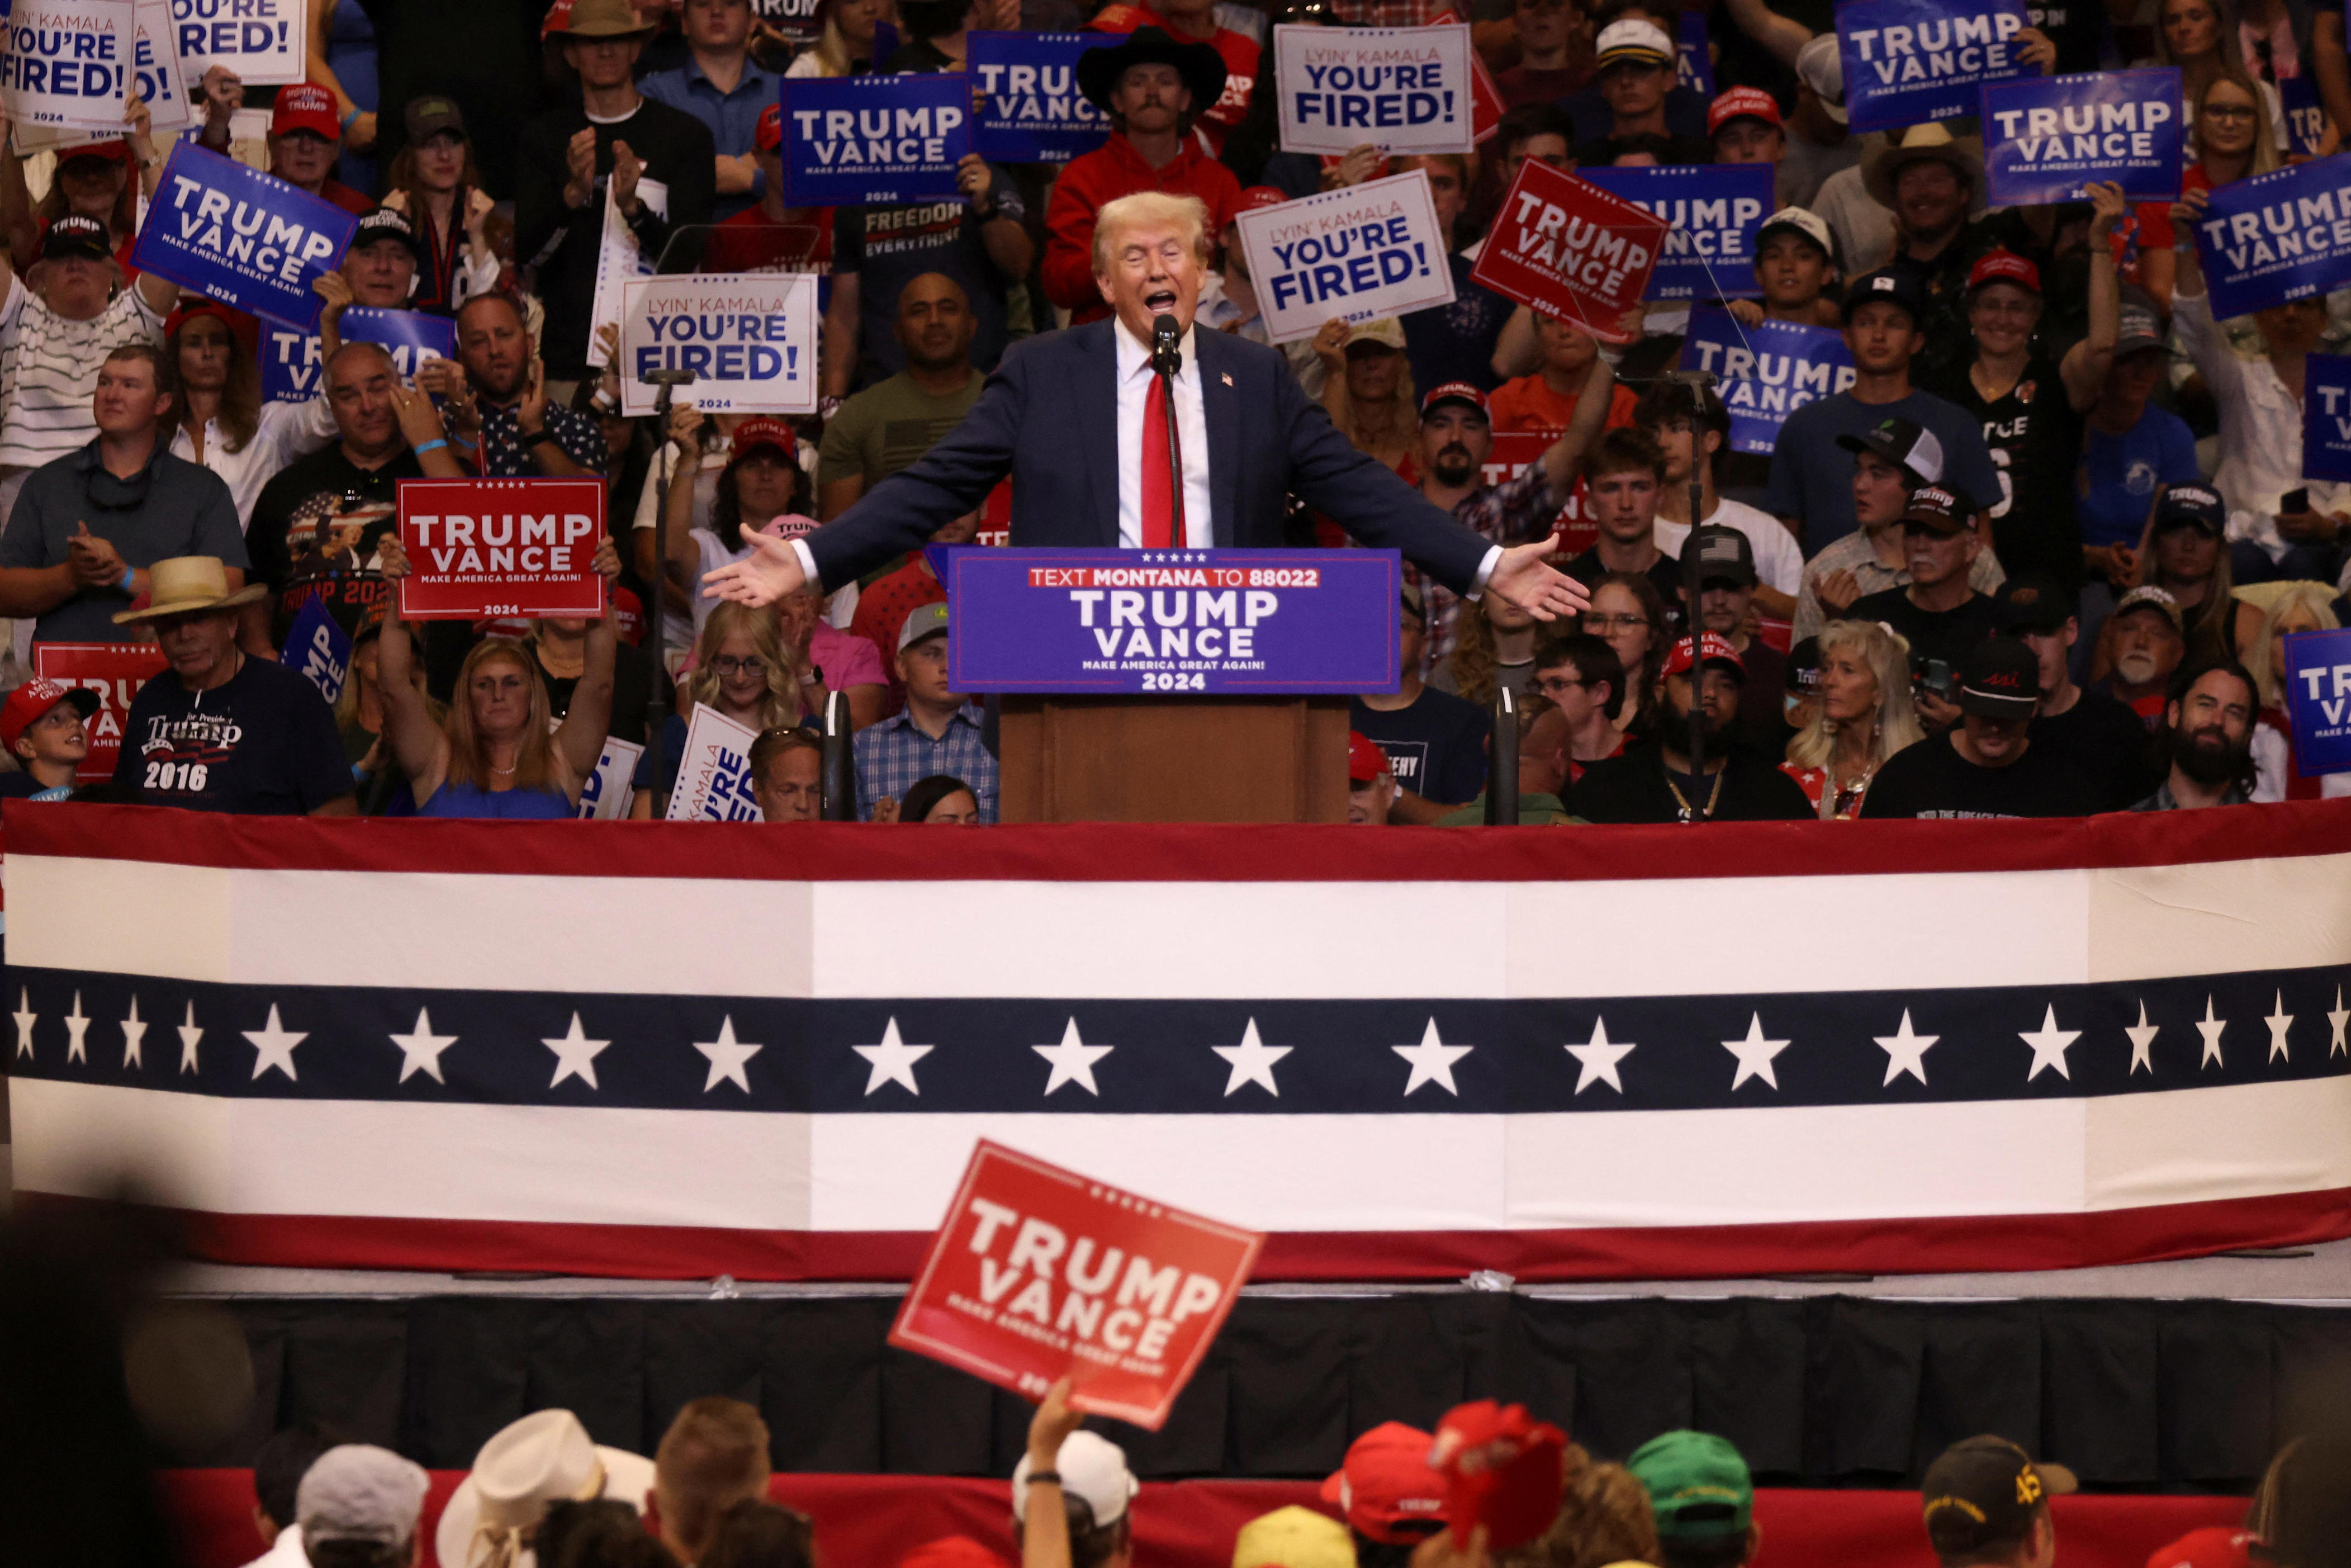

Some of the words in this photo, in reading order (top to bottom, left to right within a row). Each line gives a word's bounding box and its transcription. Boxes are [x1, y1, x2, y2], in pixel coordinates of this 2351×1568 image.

[11, 10, 35, 25] YIN'
[40, 13, 115, 32] KAMALA
[173, 0, 277, 20] OU'RE
[751, 0, 818, 17] RUM
[11, 26, 116, 60] YOU'RE
[179, 21, 288, 57] RED!
[1848, 12, 2022, 62] TRUMP
[1305, 49, 1350, 63] LYIN'
[1357, 47, 1442, 63] KAMALA
[1873, 43, 2009, 85] VANCE
[1, 54, 123, 98] FIRED!
[978, 64, 1083, 96] TRU
[1305, 64, 1442, 91] YOU'RE
[1867, 86, 1897, 98] MAKE
[1899, 78, 1945, 94] AMERICA
[1947, 72, 1980, 86] GREAT
[1982, 68, 2019, 80] AGAIN!
[286, 87, 328, 100] MONTANA
[287, 100, 327, 111] TRUMP
[34, 112, 63, 122] 2024
[1296, 91, 1453, 127] FIRED!
[1930, 105, 1963, 119] 2024
[1994, 101, 2171, 138] TRUMP
[793, 106, 963, 141] TRUMP
[813, 138, 945, 165] VANCE
[1039, 149, 1071, 160] 2024
[2016, 131, 2153, 162] VANCE
[805, 166, 833, 174] MAKE
[836, 165, 880, 174] AMERICA
[884, 164, 916, 173] GREAT
[2008, 164, 2037, 173] MAKE
[2041, 162, 2088, 171] AMERICA
[2127, 159, 2162, 167] AGAIN!
[865, 192, 898, 202] 2024
[2071, 190, 2088, 198] 20
[52, 216, 100, 235] TRUMP
[174, 175, 334, 262] TRUMP
[1269, 222, 1311, 244] LYIN'
[1320, 200, 1403, 231] KAMALA
[1631, 197, 1761, 230] UMP
[1273, 216, 1410, 270] YOU'RE
[1515, 190, 1649, 274] TRUMP
[1664, 229, 1743, 255] NCE
[2225, 219, 2351, 271] VANCE
[181, 211, 305, 284] VANCE
[162, 233, 188, 250] MAKE
[191, 245, 233, 269] AMERICA
[236, 264, 268, 283] GREAT
[269, 278, 304, 298] AGAIN!
[1499, 248, 1524, 266] MAKE
[1524, 258, 1562, 282] AMERICA
[1562, 277, 1591, 295] GREAT
[1518, 226, 1626, 297] VANCE
[2224, 271, 2249, 284] MAKE
[2252, 260, 2295, 277] AMERICA
[2297, 252, 2328, 265] GREAT
[2331, 246, 2351, 258] AGA
[1272, 243, 1430, 311] FIRED!
[206, 283, 237, 304] 2024
[1660, 286, 1694, 297] 2024
[2284, 283, 2316, 300] 2024
[648, 297, 693, 314] LYIN'
[700, 297, 785, 312] KAMALA
[1532, 296, 1561, 317] 2024
[647, 315, 786, 342] YOU'RE
[272, 331, 442, 376] TRMP
[637, 344, 797, 382] FIRED!
[1695, 340, 1857, 394] TRUMP
[699, 399, 731, 408] 2024
[1711, 379, 1827, 413] VANC
[743, 423, 787, 435] TRUMP
[1748, 439, 1775, 453] 202
[410, 514, 593, 547] TRUMP
[778, 523, 812, 533] Tru
[430, 546, 572, 572] VANCE
[421, 575, 450, 583] MAKE
[454, 574, 503, 582] AMERICA
[1031, 569, 1087, 586] TEXT
[1093, 569, 1208, 586] MONTANA
[1214, 569, 1243, 586] TO
[1249, 570, 1317, 586] 88022
[344, 581, 390, 604] 202
[484, 604, 519, 615] 2024
[1070, 590, 1278, 627] TRUMP
[1093, 628, 1254, 657] VANCE
[1683, 645, 1714, 657] GAT
[1083, 661, 1117, 669] MAKE
[1121, 661, 1174, 670] AMERICA
[1178, 661, 1218, 669] GREAT
[1222, 661, 1265, 669] AGAIN!
[50, 678, 145, 710] TRU
[1142, 673, 1206, 690] 2024
[186, 712, 197, 721] for
[148, 715, 243, 750] Trump
[2315, 727, 2342, 738] MAKE
[144, 761, 208, 792] 2016
[1388, 756, 1419, 776] EHY
[688, 745, 719, 821] KAMALA
[704, 747, 743, 821] 'RE
[1938, 809, 1956, 819] THE
[968, 1197, 1221, 1323] TRUMP
[980, 1257, 1176, 1360] VANCE
[997, 1313, 1069, 1351] AMERICA
[1018, 1371, 1050, 1394] 20
